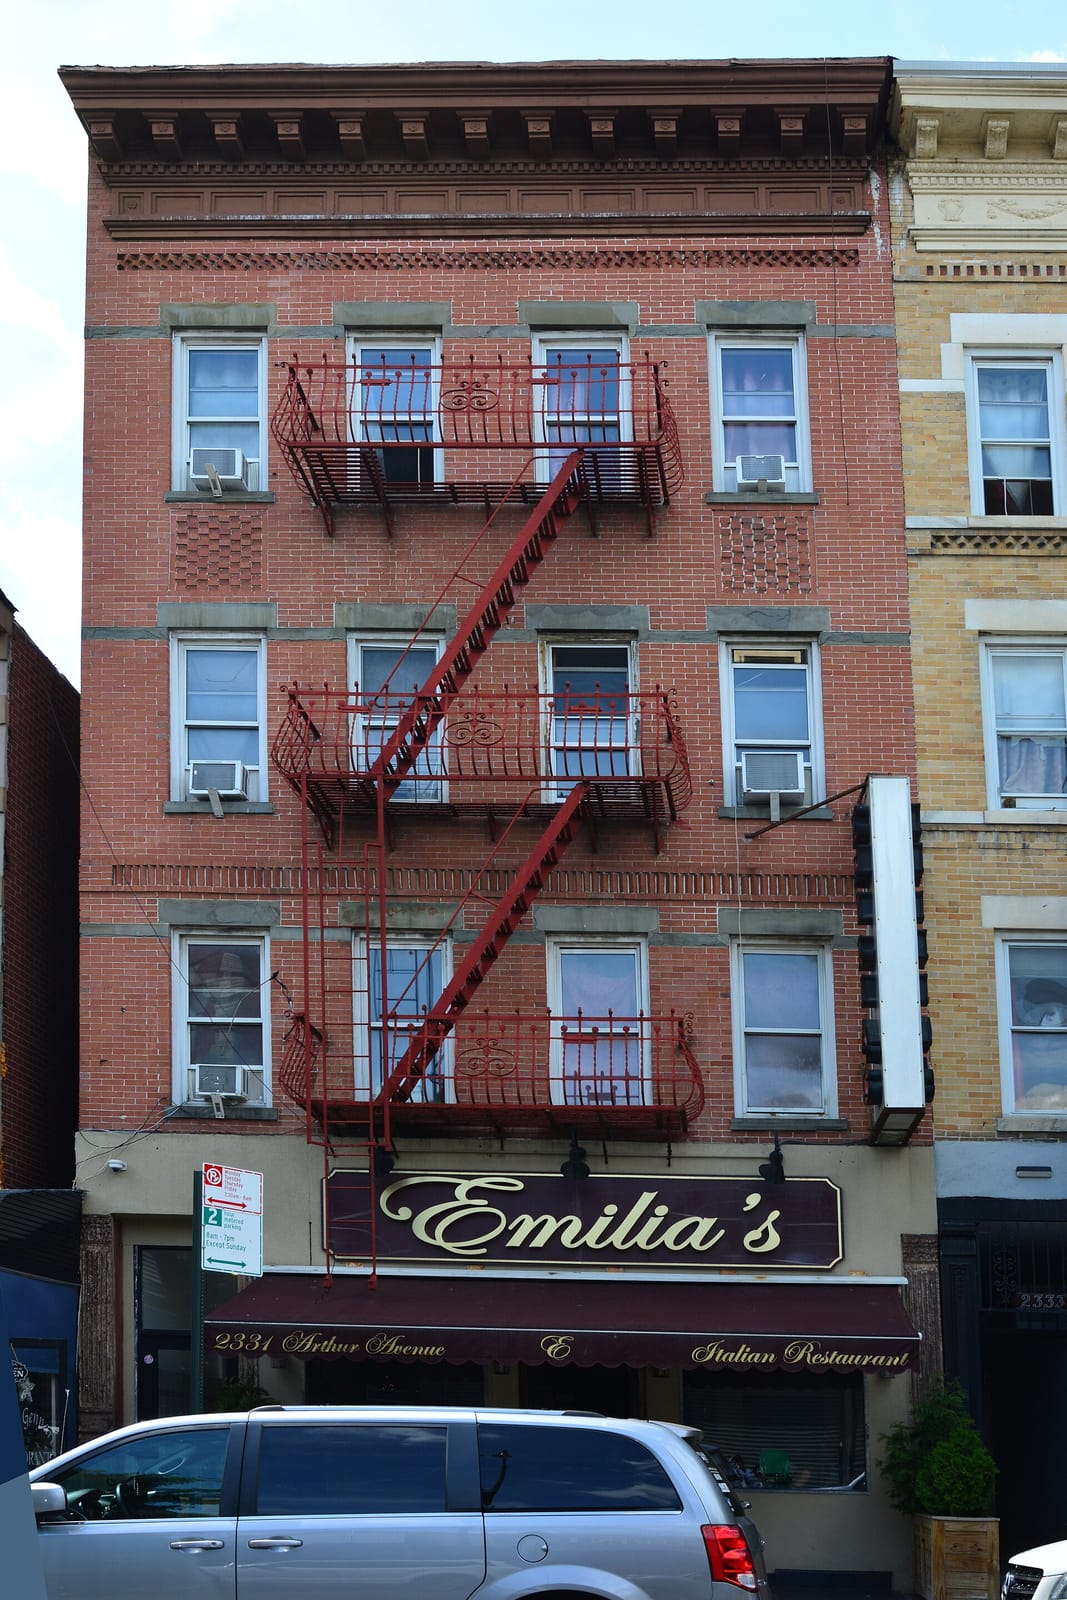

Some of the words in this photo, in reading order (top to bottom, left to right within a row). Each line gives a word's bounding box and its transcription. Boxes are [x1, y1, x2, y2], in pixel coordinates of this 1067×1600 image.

[208, 1208, 218, 1224] 2
[380, 1176, 781, 1256] Emilia's
[206, 1239, 225, 1249] Except
[226, 1242, 246, 1253] Sunday
[214, 1332, 274, 1351] 2331
[282, 1330, 360, 1353] Arthur
[365, 1332, 446, 1357] Avenue
[540, 1335, 574, 1361] E
[691, 1339, 777, 1365] Italian
[784, 1340, 910, 1367] Restaurant
